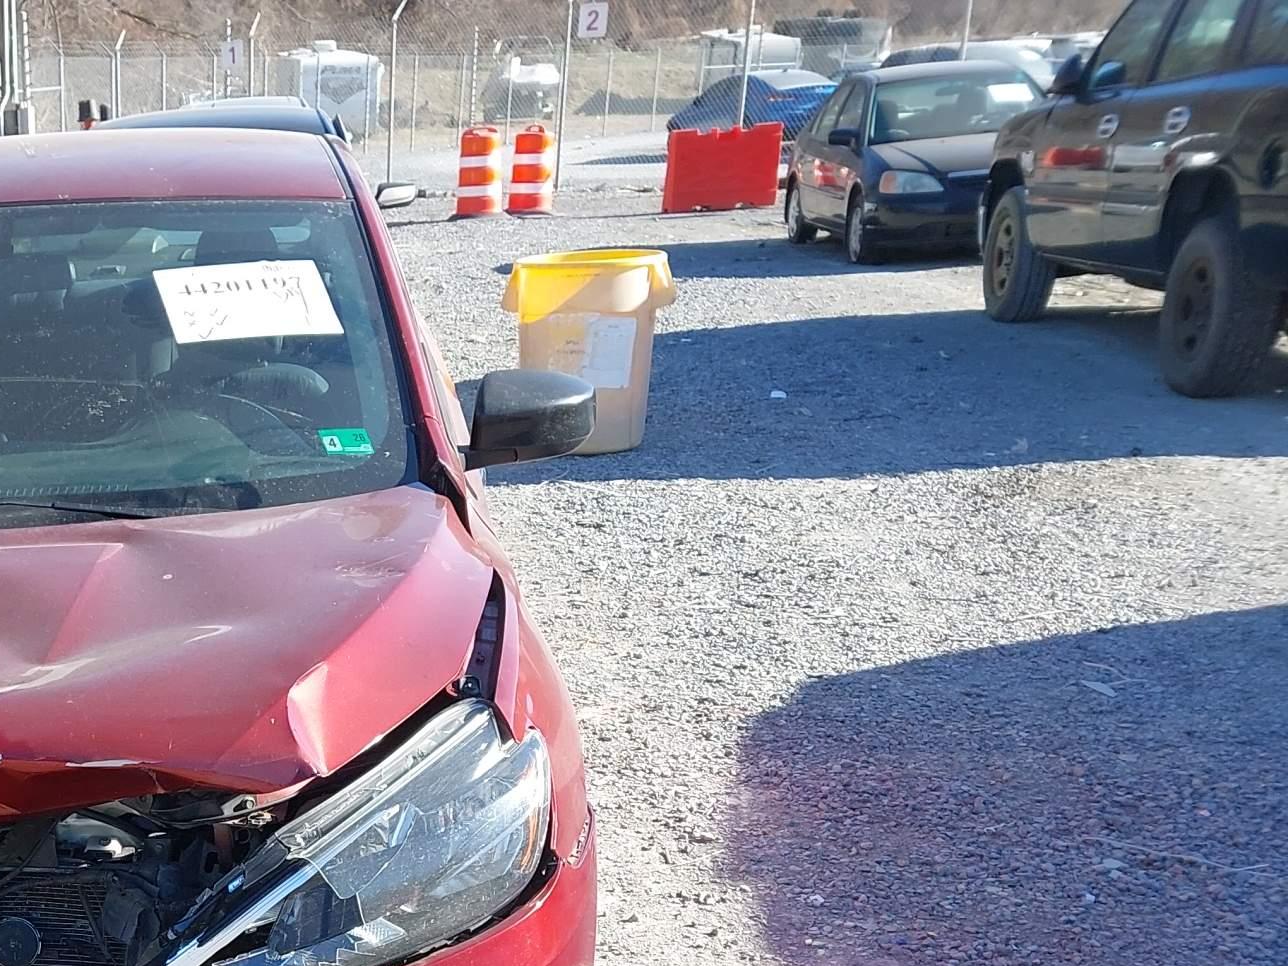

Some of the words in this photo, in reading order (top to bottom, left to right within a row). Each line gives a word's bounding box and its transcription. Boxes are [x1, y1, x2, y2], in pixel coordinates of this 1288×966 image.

[586, 9, 600, 32] 2
[228, 46, 236, 65] 1
[328, 437, 337, 448] 4
